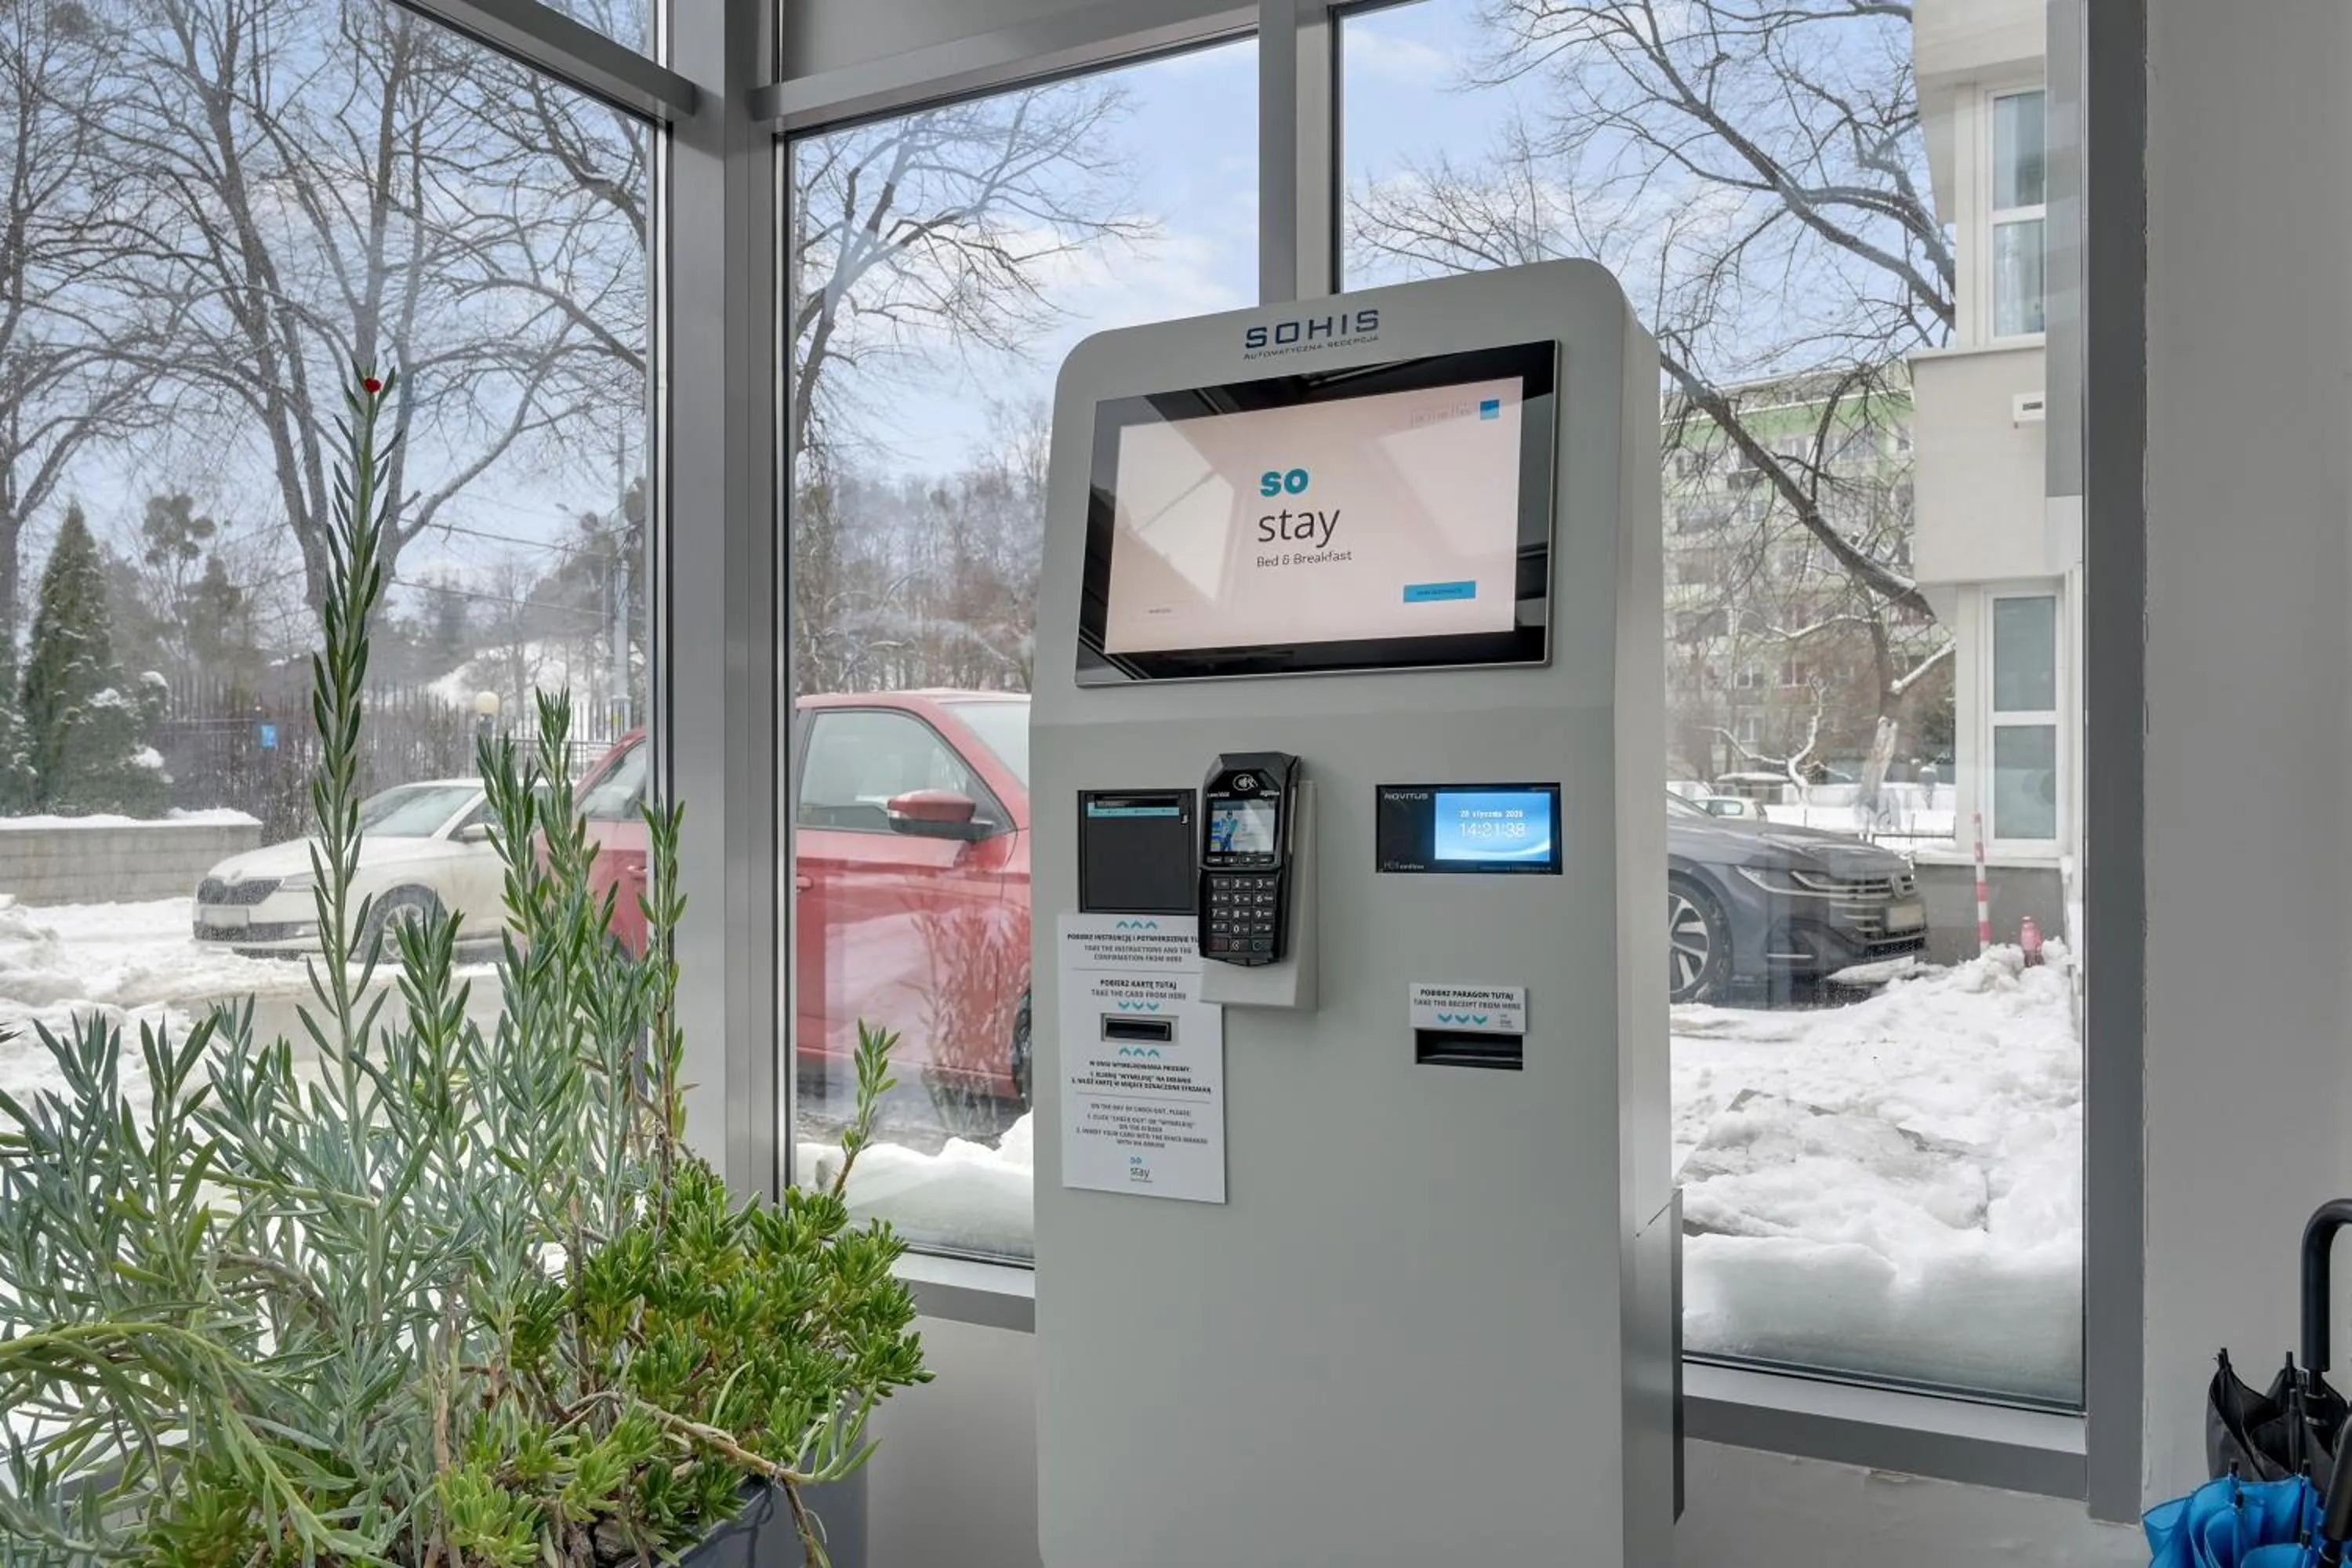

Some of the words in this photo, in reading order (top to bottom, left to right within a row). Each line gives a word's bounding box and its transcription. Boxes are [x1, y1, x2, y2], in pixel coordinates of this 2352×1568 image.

[1245, 310, 1379, 349] SOHIS
[1243, 343, 1323, 361] AUTOMATYCZNA
[1327, 335, 1380, 348] RECEPCJA
[1260, 468, 1308, 498] so
[1258, 509, 1340, 549] stay
[1257, 555, 1279, 568] Bed
[1282, 554, 1290, 565] &
[1293, 551, 1352, 564] Breakfast
[1459, 822, 1526, 838] 14:21:38
[1257, 879, 1263, 888] 3
[1257, 895, 1263, 903] 6
[1156, 981, 1177, 990] TUTAJ
[1452, 990, 1490, 999] PARAGON
[1491, 991, 1514, 1000] TUTAJ
[1448, 1000, 1477, 1009] RECEIPT
[1130, 1167, 1150, 1180] stay
